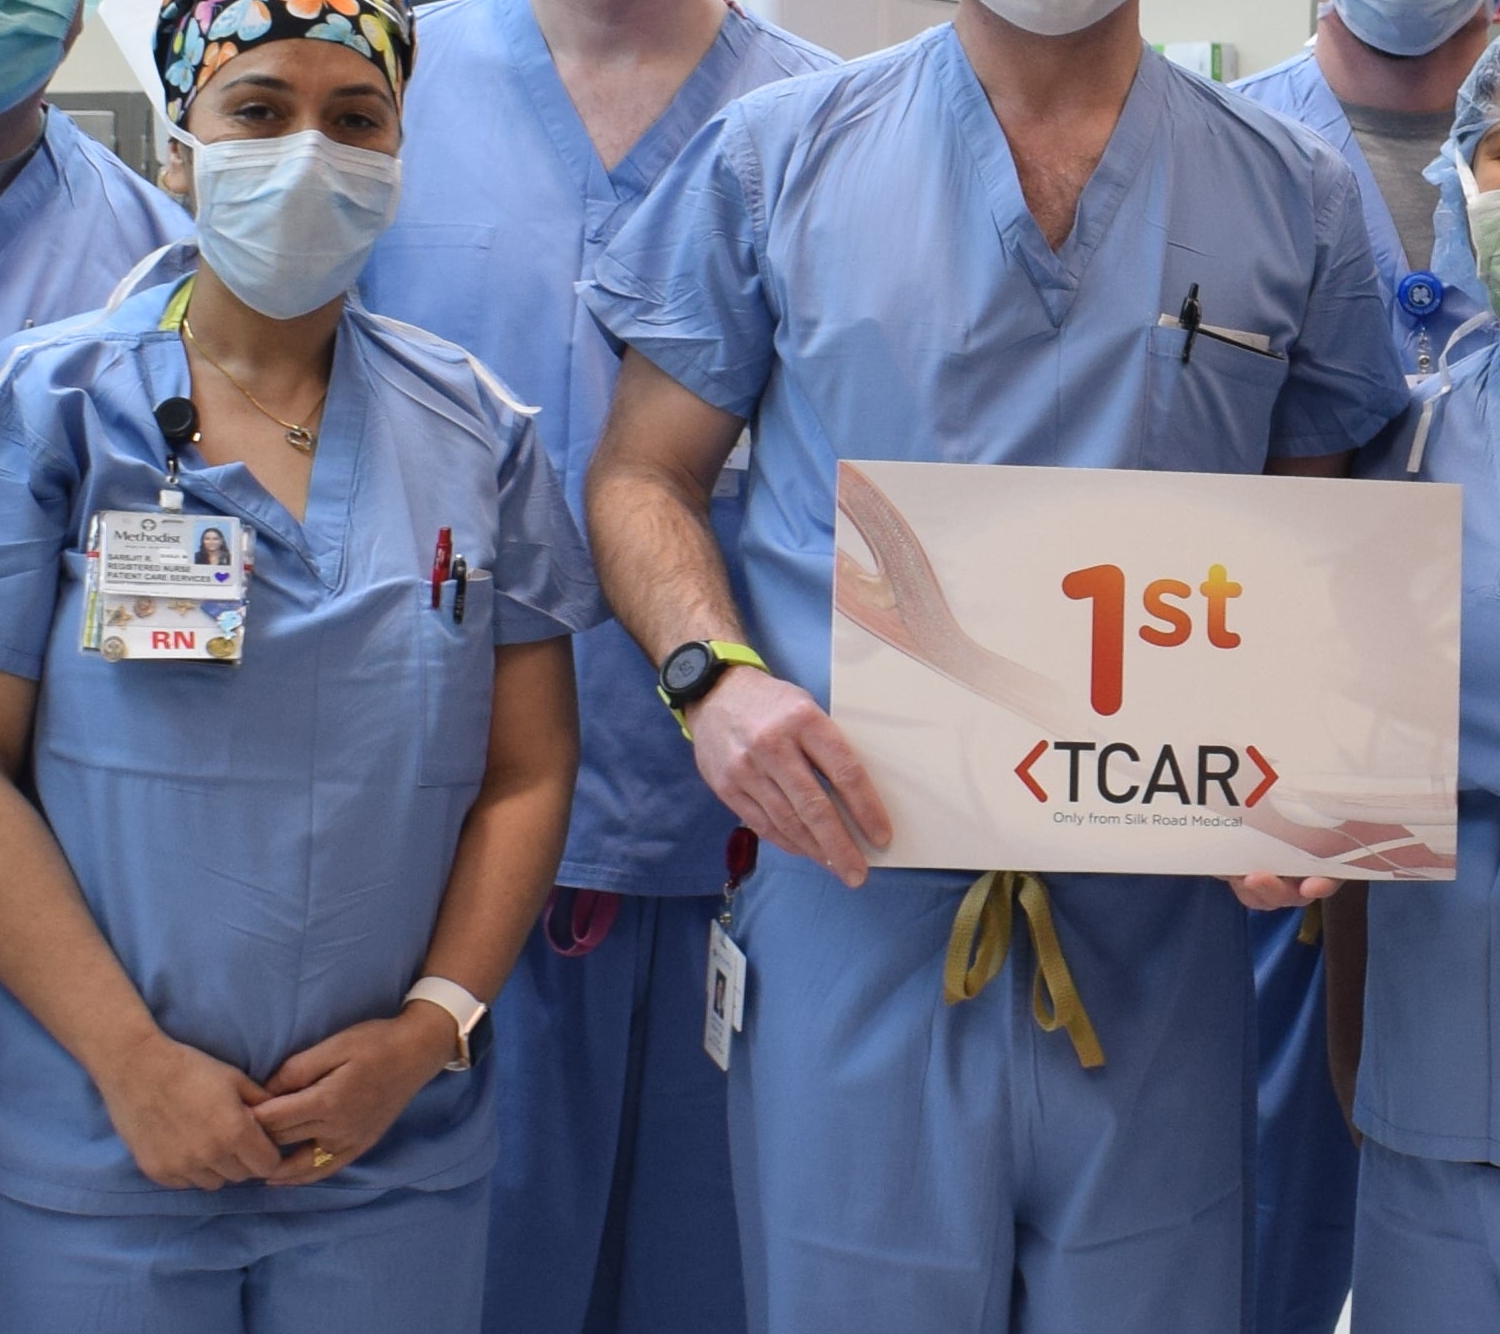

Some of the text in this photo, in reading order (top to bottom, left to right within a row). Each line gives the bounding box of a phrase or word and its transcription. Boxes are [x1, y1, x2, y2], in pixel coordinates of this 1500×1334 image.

[113, 529, 181, 544] Methodist
[107, 562, 191, 573] REGISTERED NURSE
[107, 571, 211, 583] PATIENT CARE SERVICES
[152, 630, 195, 649] RN
[1061, 563, 1243, 717] 1st
[1052, 811, 1243, 828] Only from Silk Road Medical
